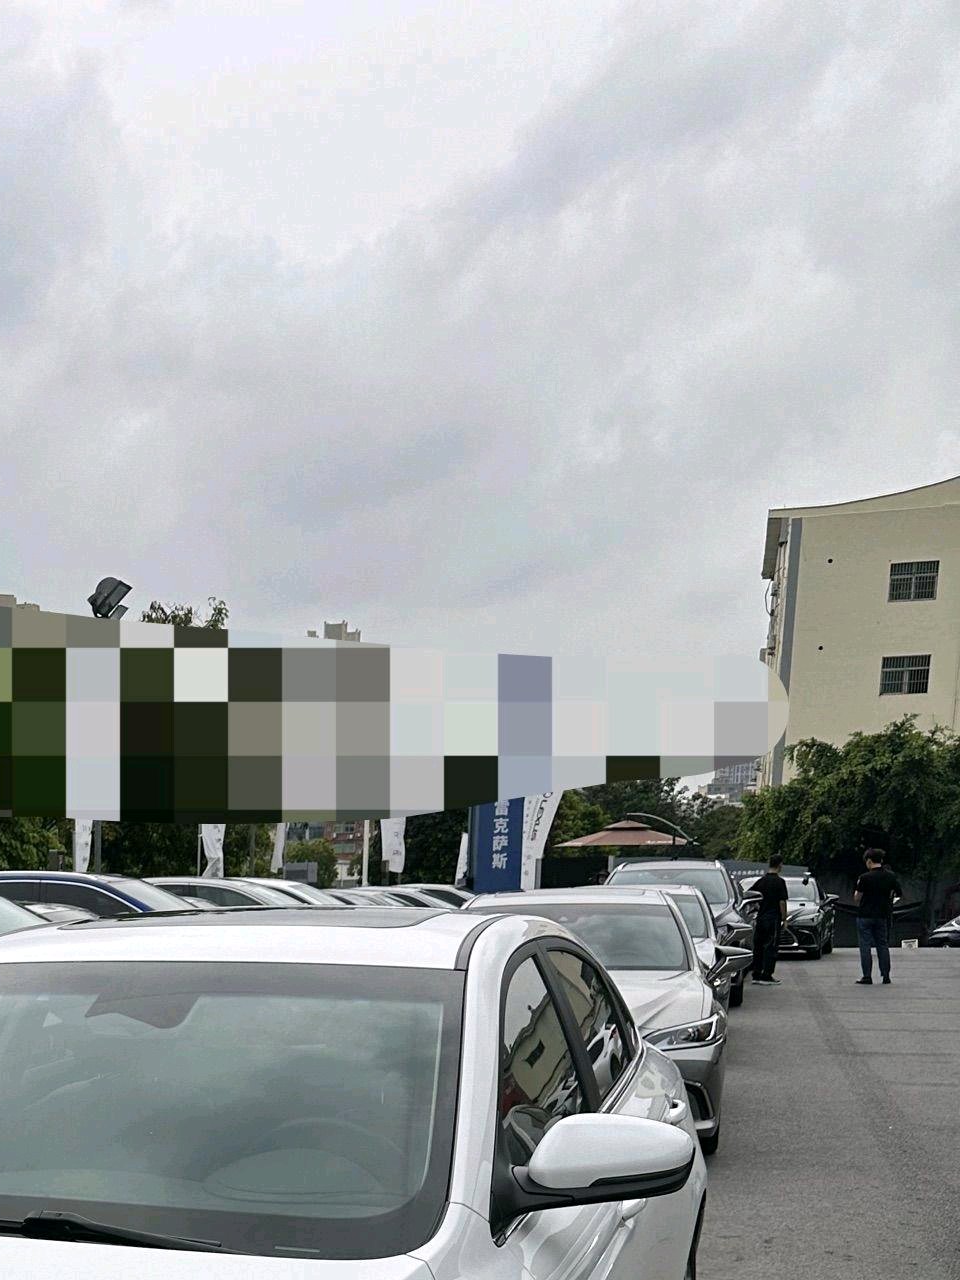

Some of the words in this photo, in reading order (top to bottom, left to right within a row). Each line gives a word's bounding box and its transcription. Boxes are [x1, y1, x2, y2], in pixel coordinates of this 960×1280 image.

[492, 800, 510, 869] 雷克萨斯
[530, 799, 548, 841] LEXUS
